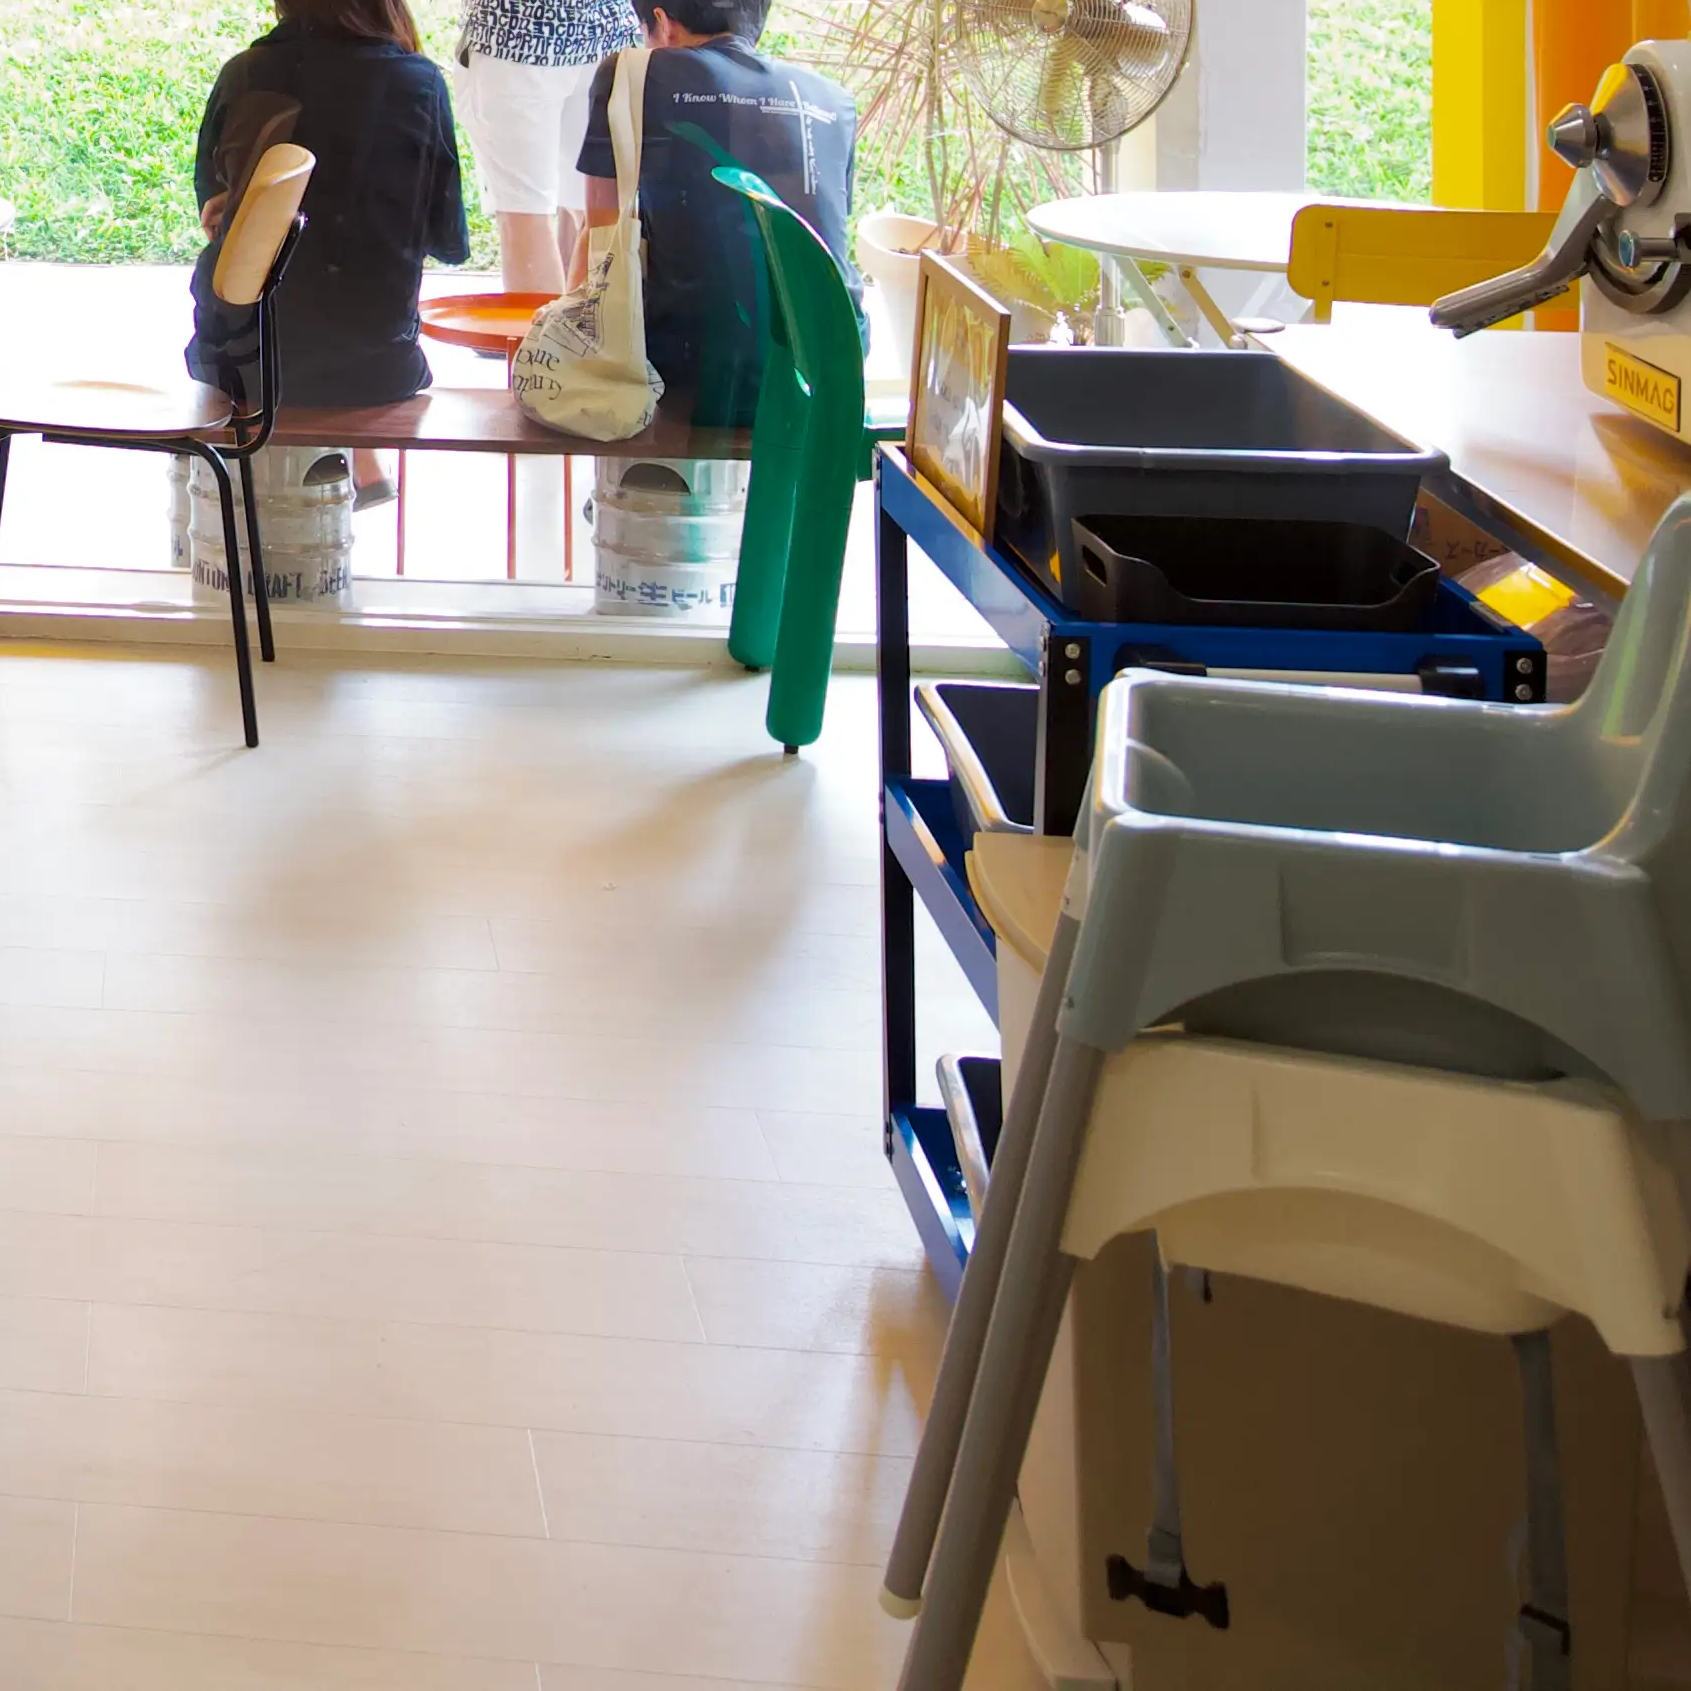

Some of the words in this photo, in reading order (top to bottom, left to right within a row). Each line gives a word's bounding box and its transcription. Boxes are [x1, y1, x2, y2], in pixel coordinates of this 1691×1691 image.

[682, 93, 717, 104] Know
[719, 93, 758, 106] Whom
[1607, 358, 1675, 414] SINMAG
